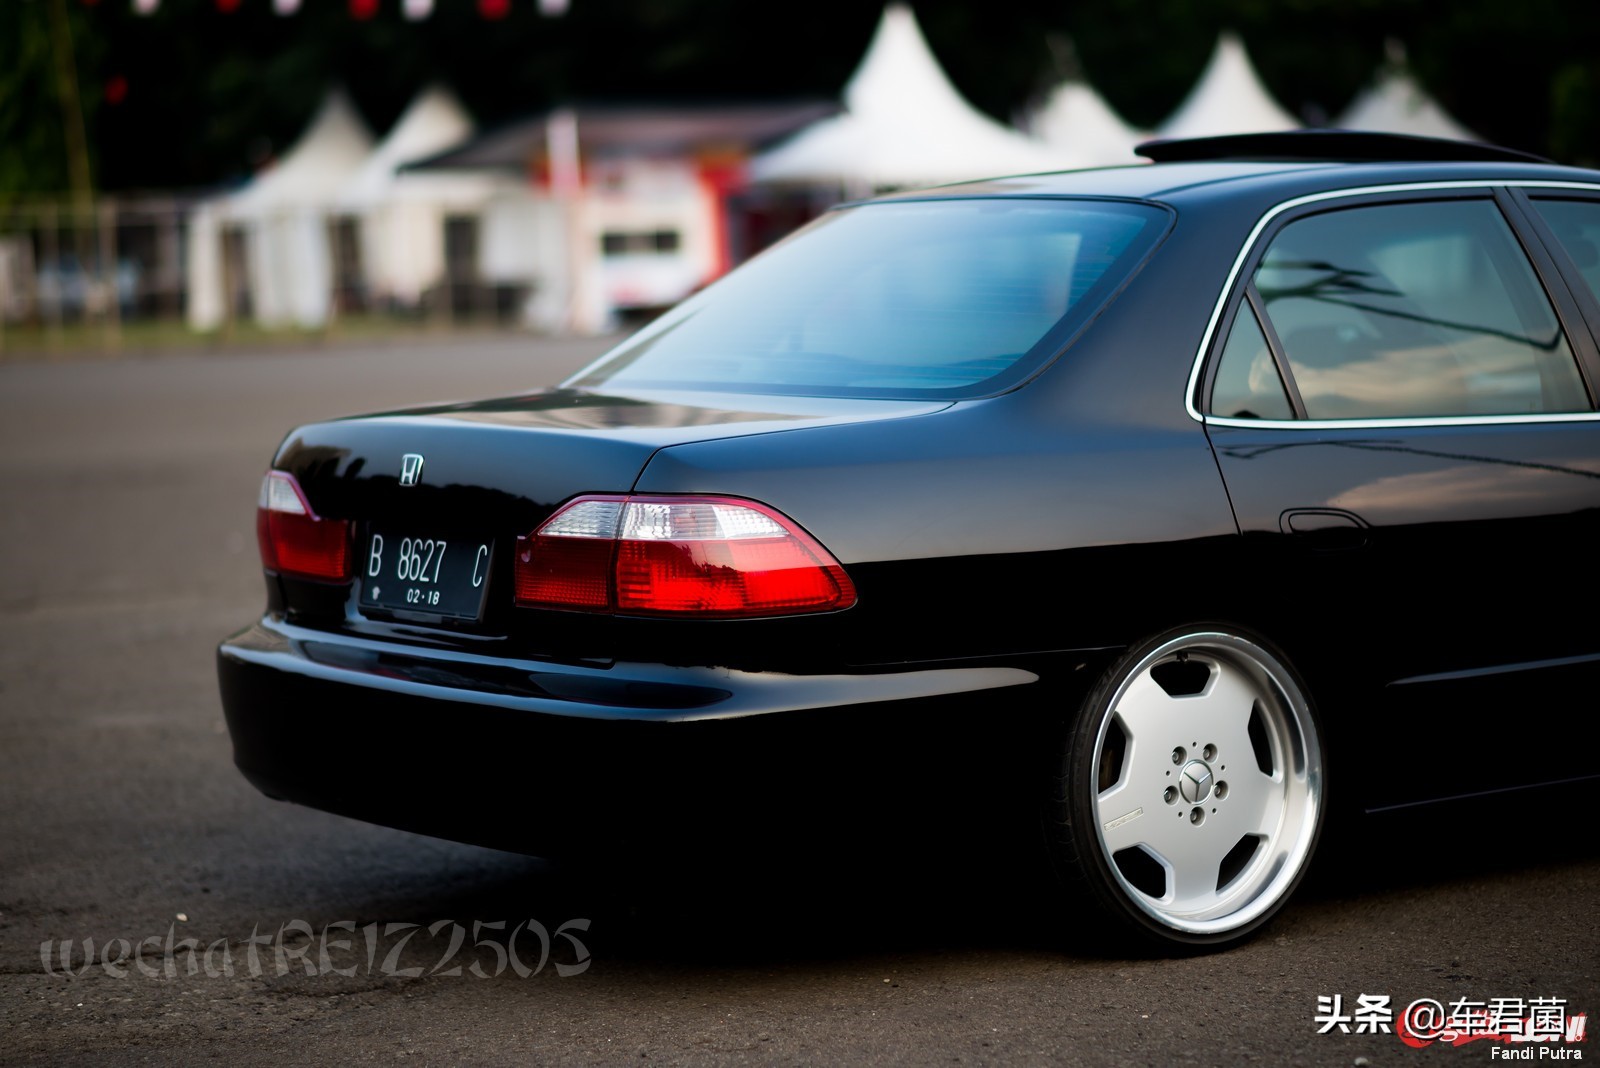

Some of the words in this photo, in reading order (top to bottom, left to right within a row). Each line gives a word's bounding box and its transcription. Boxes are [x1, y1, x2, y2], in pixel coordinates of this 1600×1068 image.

[368, 534, 384, 577] B
[397, 537, 447, 584] 8627
[472, 544, 488, 588] C
